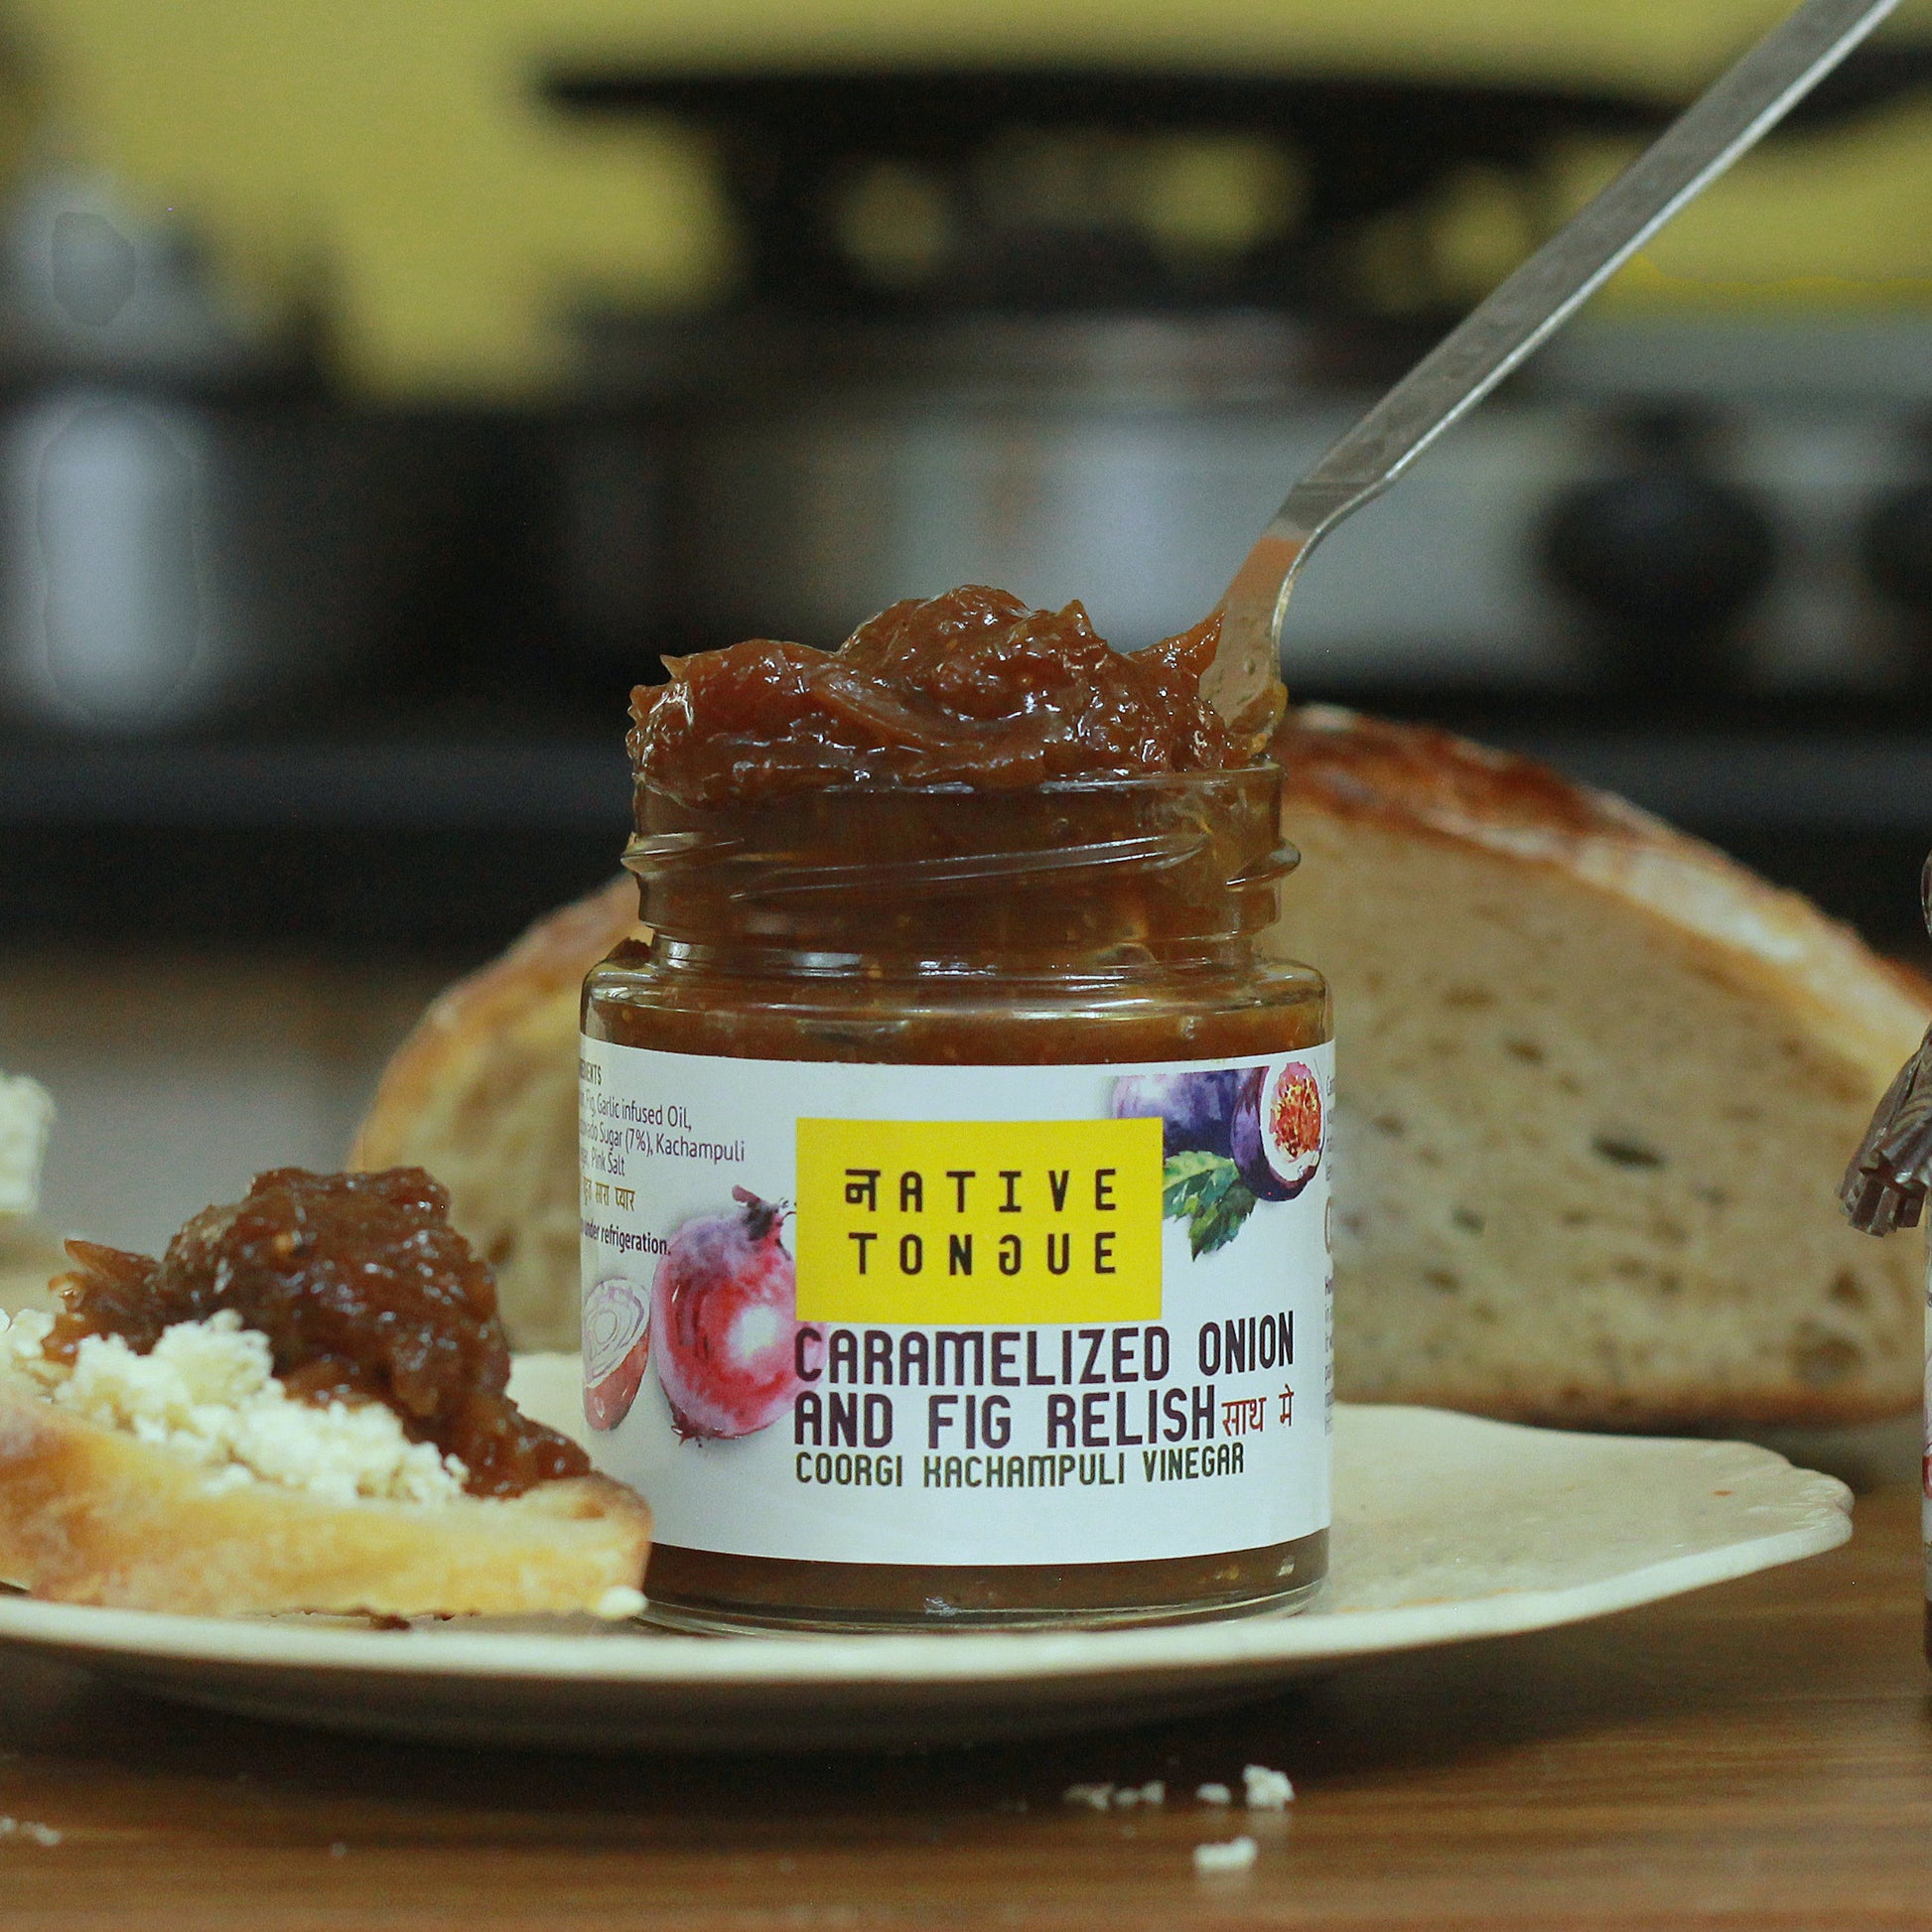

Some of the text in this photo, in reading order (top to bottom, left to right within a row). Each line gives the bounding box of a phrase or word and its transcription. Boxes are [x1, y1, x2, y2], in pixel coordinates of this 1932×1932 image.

[597, 1093, 620, 1119] Garlic
[621, 1099, 663, 1126] infused
[667, 1105, 692, 1132] Oil,
[600, 1123, 622, 1154] Sugar
[625, 1128, 653, 1158] (7%),
[656, 1133, 745, 1165] Kachampuli
[608, 1153, 625, 1176] Salt
[601, 1224, 671, 1256] refrigeration.
[795, 1311, 1294, 1386] CARAMELIZED ONION
[794, 1384, 1216, 1449] AND FIG RELISH
[795, 1442, 1245, 1488] COORGI KACHAMPULI VINEGAR
